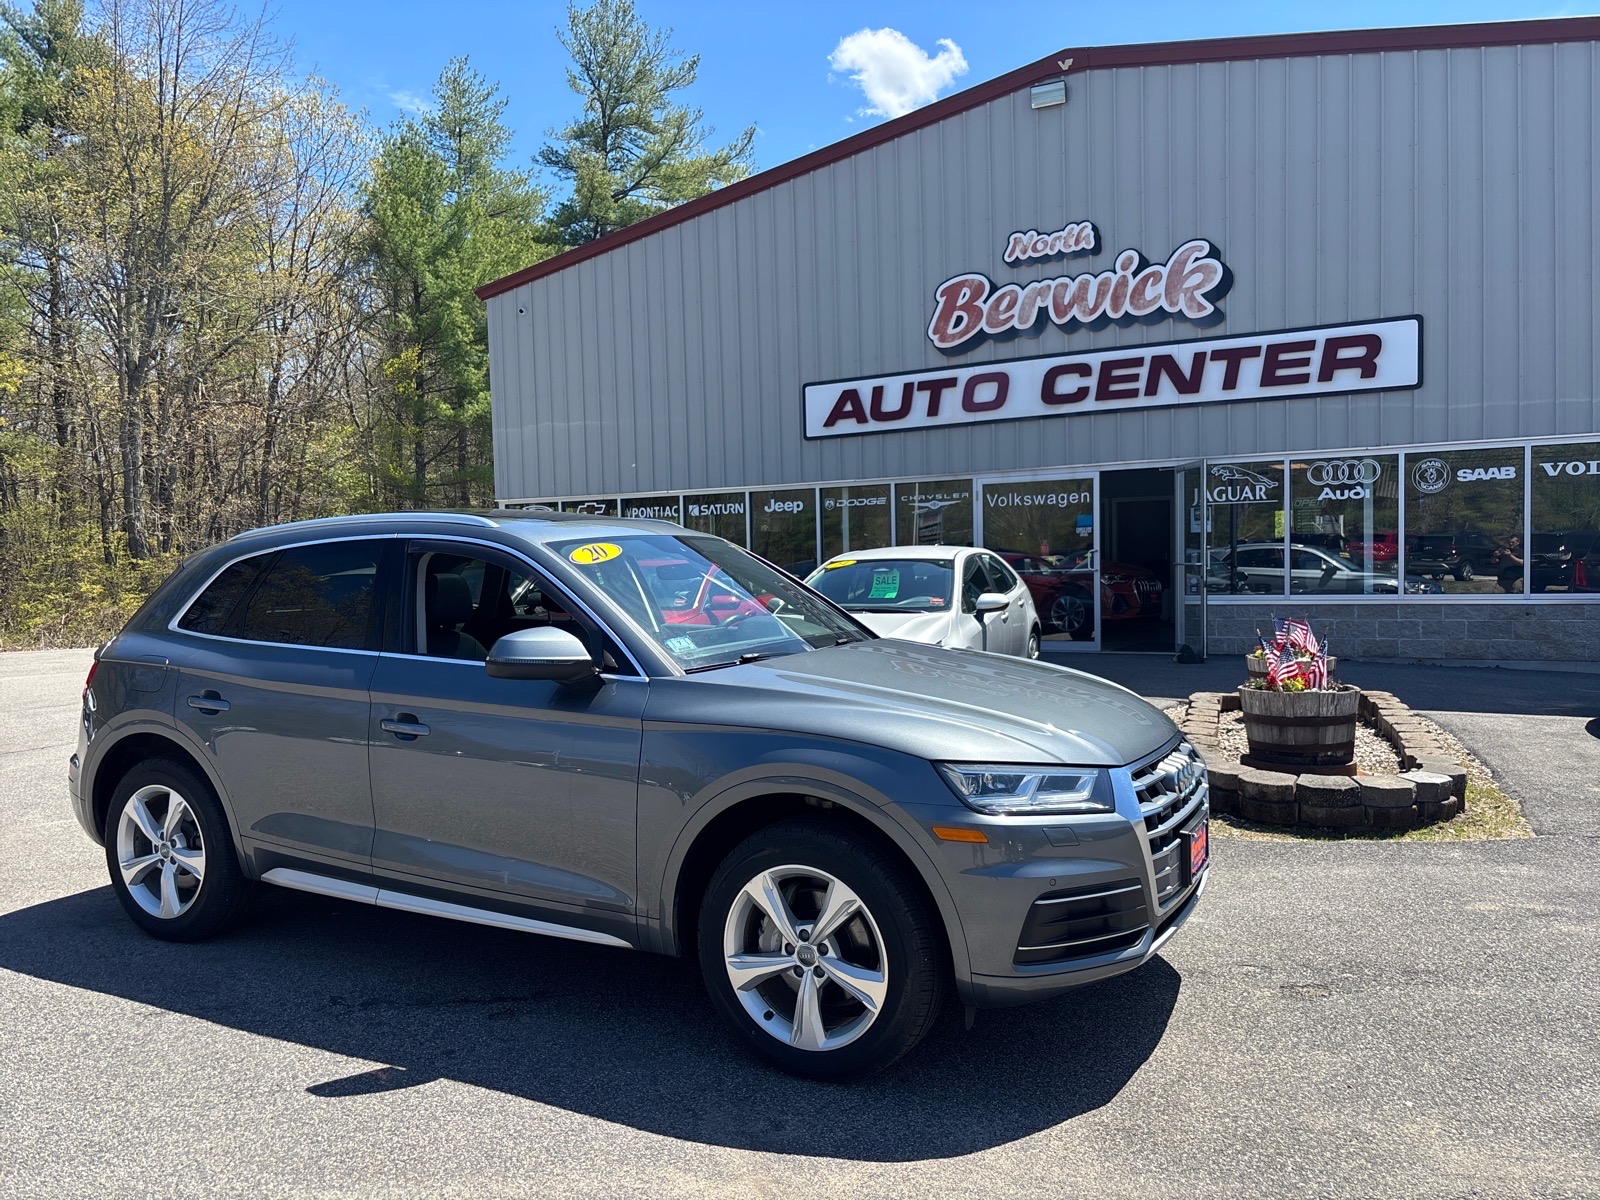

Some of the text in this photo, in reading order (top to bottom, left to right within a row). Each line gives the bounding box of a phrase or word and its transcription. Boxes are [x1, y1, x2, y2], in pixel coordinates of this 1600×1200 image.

[1006, 221, 1095, 263] North
[929, 240, 1223, 348] Berwick
[822, 334, 1382, 428] AUTO CENTER
[1456, 466, 1517, 482] SAAB
[901, 492, 969, 502] CHRYSLER
[986, 491, 1090, 508] Volkswagen
[1317, 485, 1371, 501] Audi
[700, 503, 744, 516] SATURN
[764, 499, 803, 514] Jeep
[836, 497, 887, 507] DODGE
[632, 505, 678, 519] PONTIAC
[582, 545, 608, 562] 20
[875, 575, 898, 586] SALE
